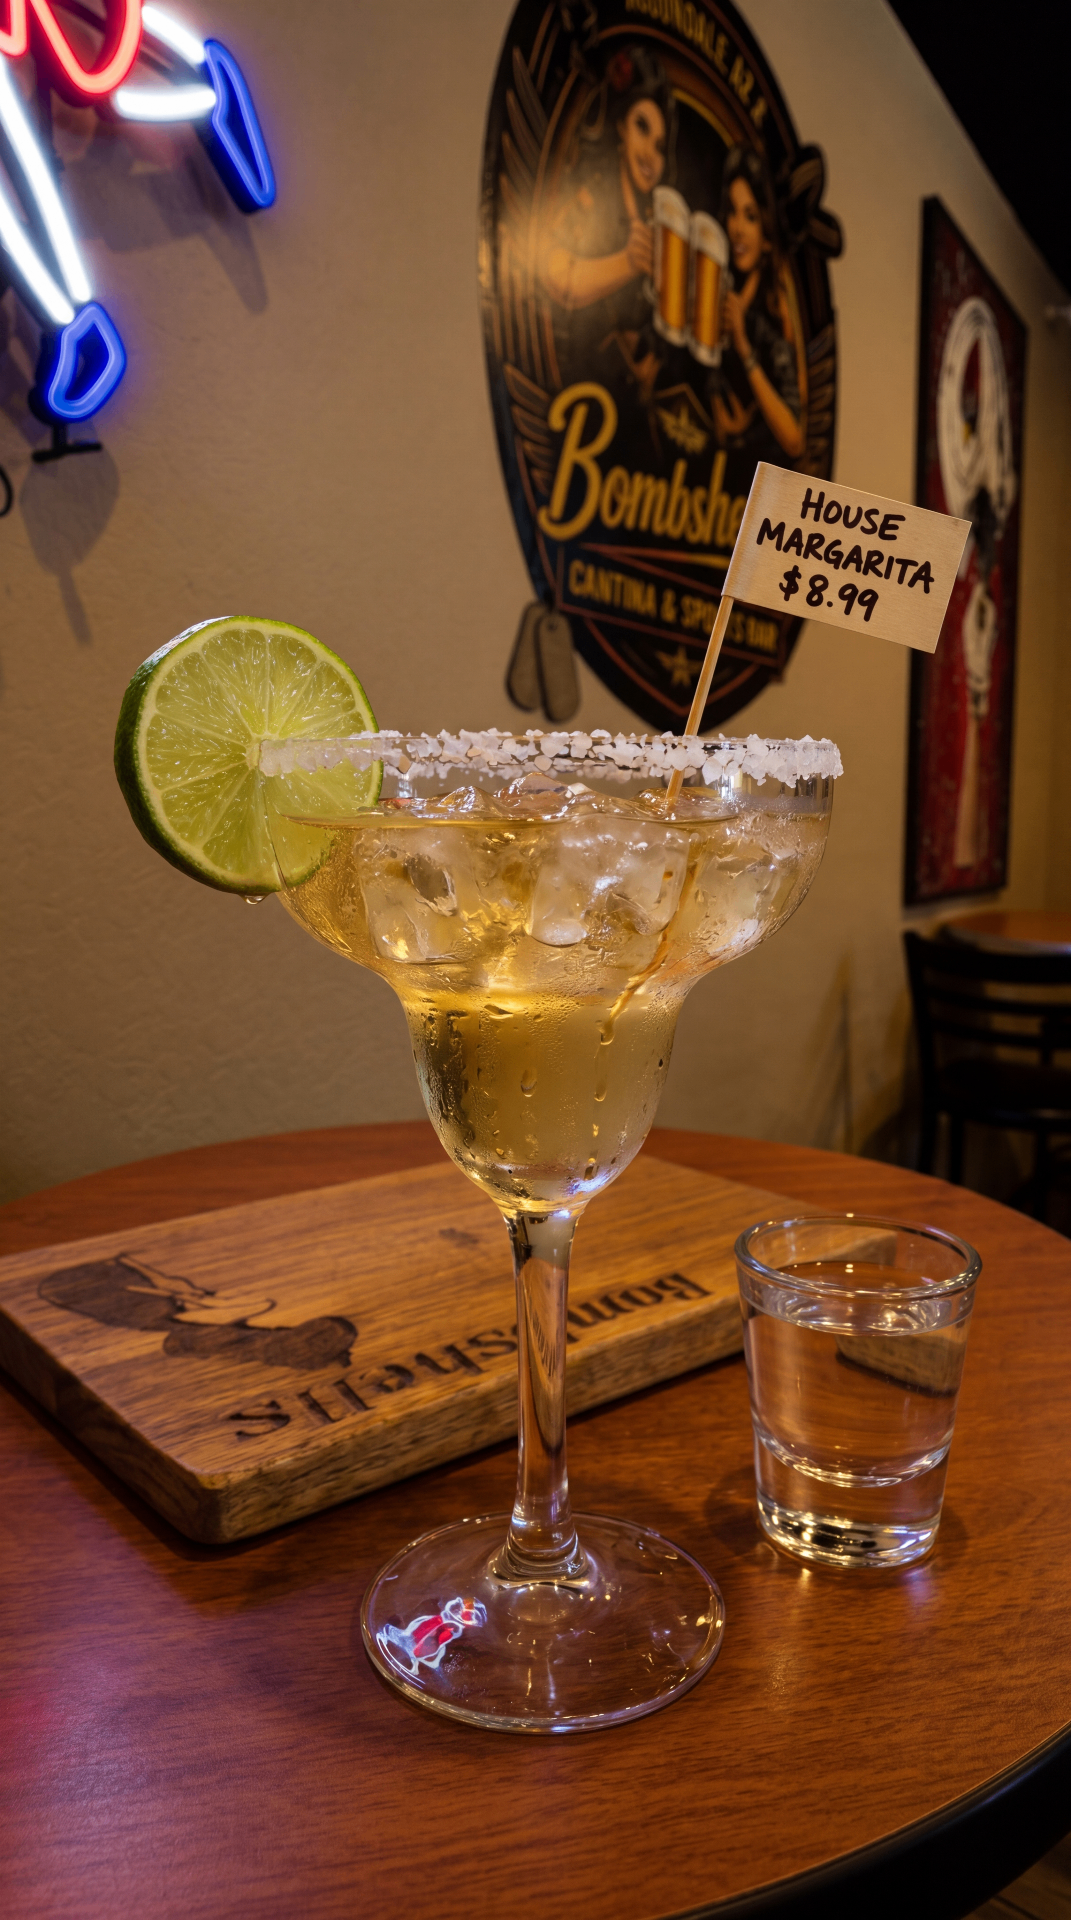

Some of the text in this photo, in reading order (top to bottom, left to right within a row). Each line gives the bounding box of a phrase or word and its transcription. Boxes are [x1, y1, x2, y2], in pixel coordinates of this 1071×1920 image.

[537, 381, 748, 548] Bombshe
[800, 487, 906, 541] HOUSE
[569, 559, 657, 618] CANTINA
[660, 588, 677, 624] &
[756, 517, 935, 595] MARGARITA
[778, 565, 879, 622] $8.99
[229, 1273, 713, 1442] Bomshells
